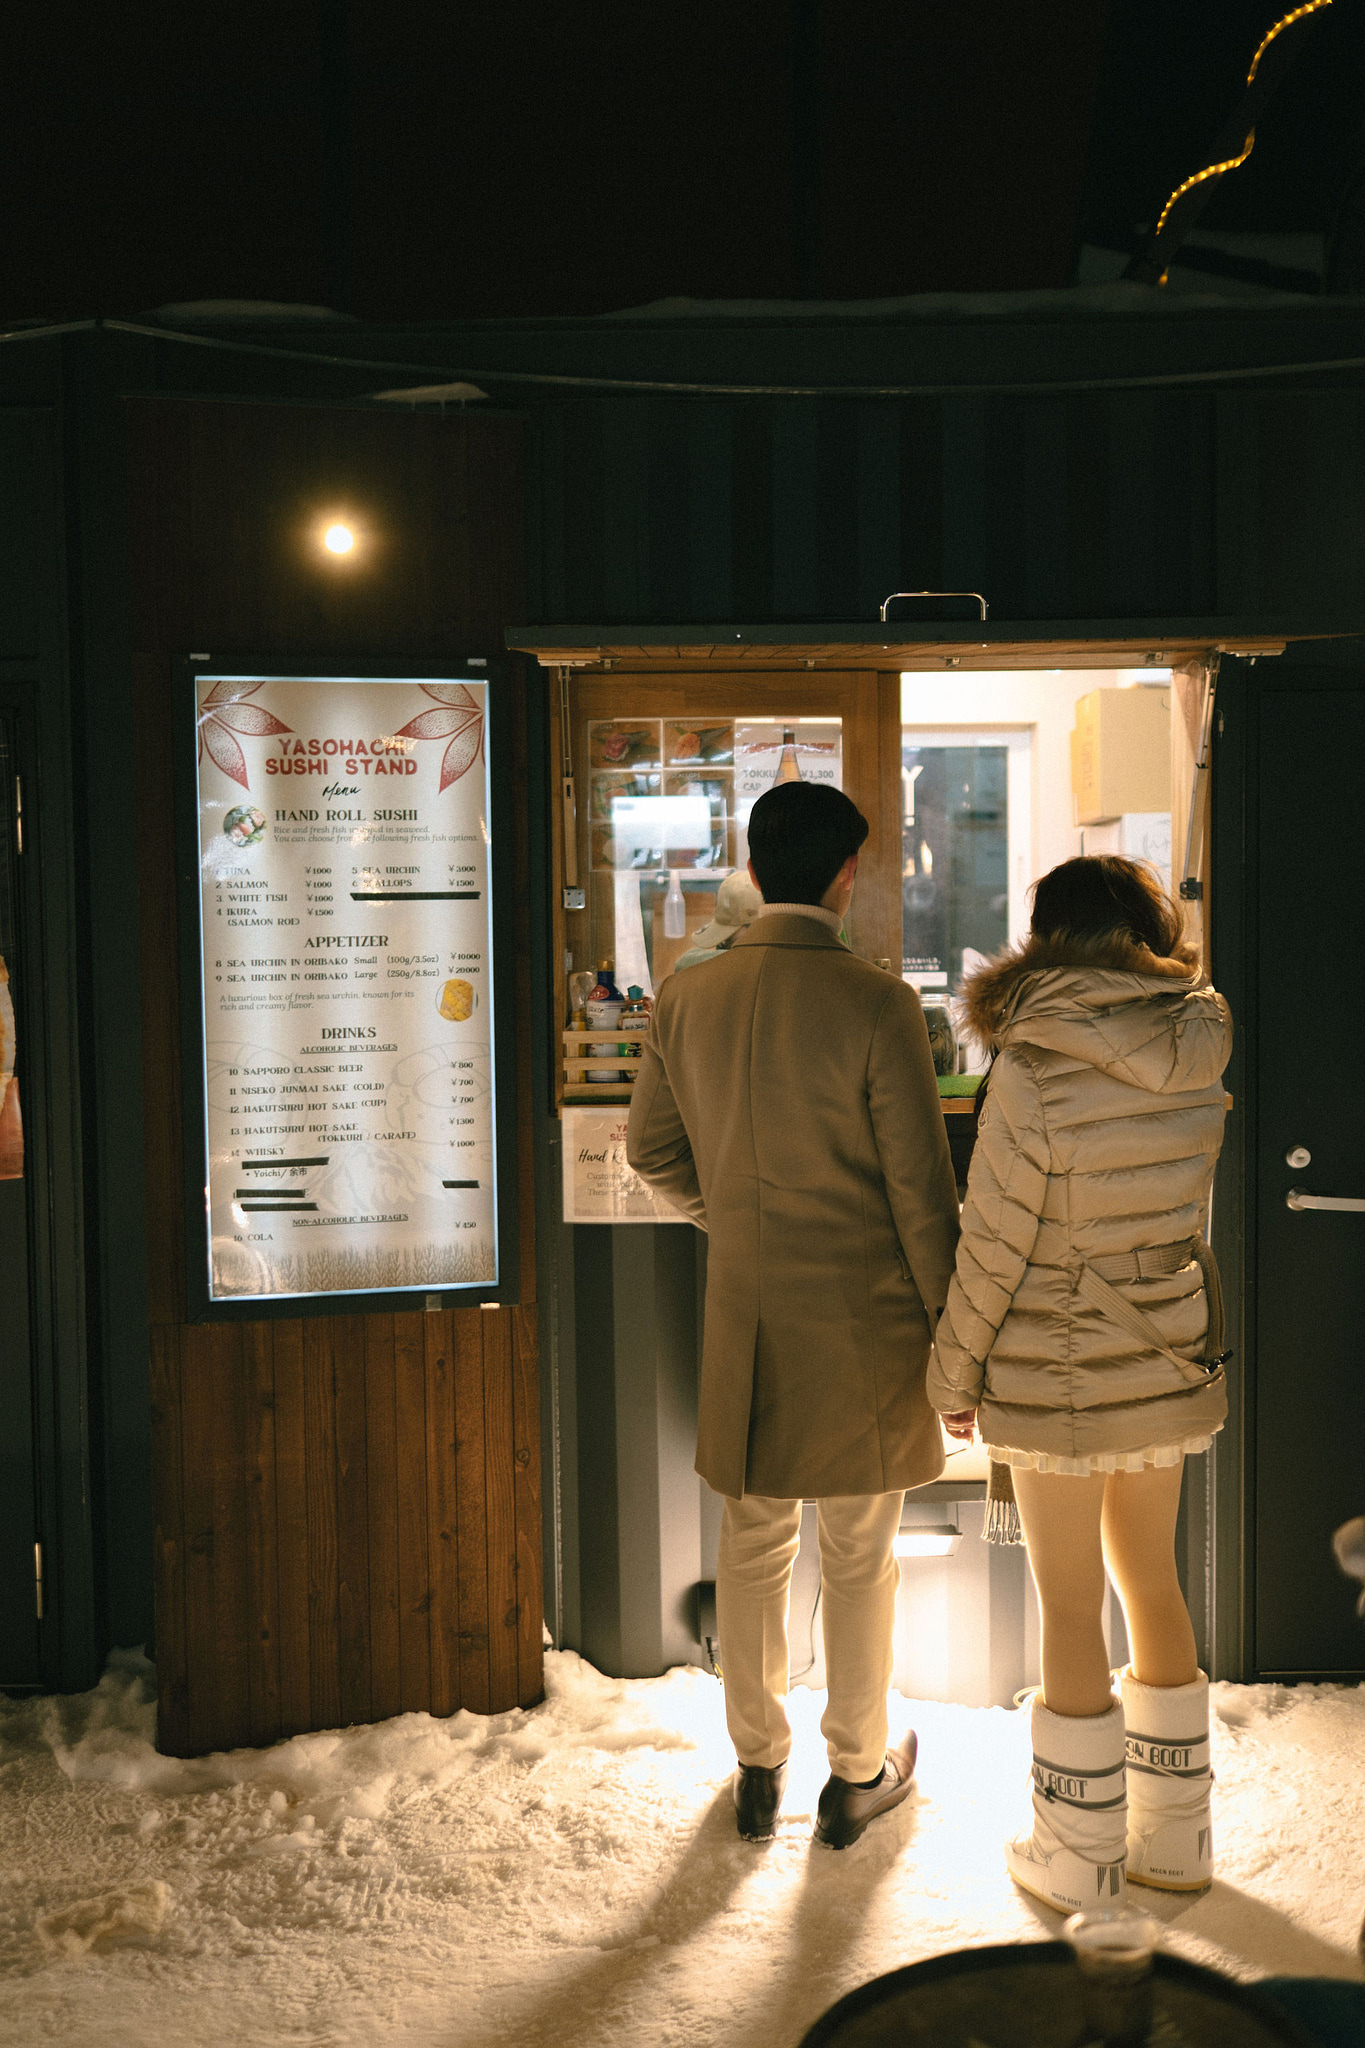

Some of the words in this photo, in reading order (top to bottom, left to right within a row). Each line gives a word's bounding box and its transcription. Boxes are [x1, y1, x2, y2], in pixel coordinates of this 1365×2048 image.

[278, 738, 405, 756] YASOHACHI
[265, 758, 328, 775] SUSHI
[345, 758, 418, 775] STAND
[322, 781, 361, 801] Menu
[275, 809, 319, 821] HAND
[326, 809, 366, 821] ROLL
[373, 809, 418, 821] SUSHI
[273, 826, 291, 834] Rice
[293, 826, 307, 834] and
[309, 826, 330, 835] fresh
[331, 826, 347, 835] fish
[273, 834, 290, 842] You
[308, 834, 335, 842] choose
[372, 834, 409, 844] following
[410, 834, 431, 844] fresh
[431, 833, 447, 844] fish
[448, 833, 479, 843] options.
[352, 866, 358, 874] 5
[362, 866, 381, 874] SEA
[385, 866, 421, 874] URCHIN
[215, 881, 222, 889] 2
[226, 881, 269, 889] SALMON
[216, 894, 222, 902] 3
[228, 894, 262, 902] WHITE
[265, 894, 288, 902] FISH
[216, 908, 222, 916] 4
[226, 908, 258, 916] IKURA
[227, 918, 273, 926] (SALMON
[277, 917, 300, 926] ROE)
[304, 935, 389, 948] APPETIZER
[215, 960, 222, 968] 8
[250, 958, 287, 967] URCHIN
[291, 958, 300, 966] IN
[304, 957, 348, 966] ORIBAKO
[354, 956, 378, 965] Small
[386, 954, 440, 965] (100g/3.5oz)
[215, 974, 222, 983] 9
[226, 974, 246, 983] SEA
[250, 973, 287, 981] URCHIN
[291, 973, 300, 981] IN
[304, 972, 348, 980] ORIBAKO
[354, 970, 378, 980] Large
[386, 969, 440, 979] (250g/8.8oz)
[220, 994, 226, 1002] A
[228, 993, 267, 1001] luxurious
[269, 993, 282, 1001] box
[285, 993, 294, 1004] of
[294, 992, 315, 1003] fresh
[362, 991, 390, 999] known
[391, 991, 402, 1000] for
[220, 1003, 237, 1011] rich
[256, 1003, 286, 1012] creamy
[287, 1001, 314, 1011] flavor.
[321, 1027, 377, 1039] DRINKS
[300, 1045, 346, 1053] ALCOHOLIC
[349, 1043, 398, 1052] BEVERAGES
[229, 1068, 238, 1076] 10
[243, 1066, 290, 1075] SAPPORO
[293, 1065, 335, 1074] CLASSIC
[338, 1064, 363, 1073] BEER
[229, 1088, 236, 1096] 11
[241, 1086, 276, 1095] NISEKO
[280, 1084, 318, 1094] JUNMAI
[322, 1083, 349, 1092] SAKE
[353, 1082, 385, 1091] (COLD)
[230, 1106, 240, 1114] 12
[243, 1103, 304, 1113] HAKUTSURU
[308, 1102, 328, 1111] HOT
[331, 1101, 358, 1110] SAKE
[361, 1099, 387, 1107] (CUP)
[230, 1127, 240, 1136] 13
[244, 1125, 305, 1135] HAKUTSURU
[308, 1124, 329, 1133] HOT
[332, 1123, 359, 1132] SAKE
[317, 1133, 363, 1142] (TOKKURI
[374, 1131, 416, 1140] CARAFE)
[245, 1147, 286, 1156] WHISKY
[578, 1148, 608, 1163] Hand
[292, 1216, 358, 1226] NON-ALCOHOLIC
[360, 1213, 409, 1222] BEVERAGES
[247, 1233, 274, 1241] COLA
[1150, 1746, 1191, 1767] BOOT
[1048, 1773, 1087, 1798] BOOT
